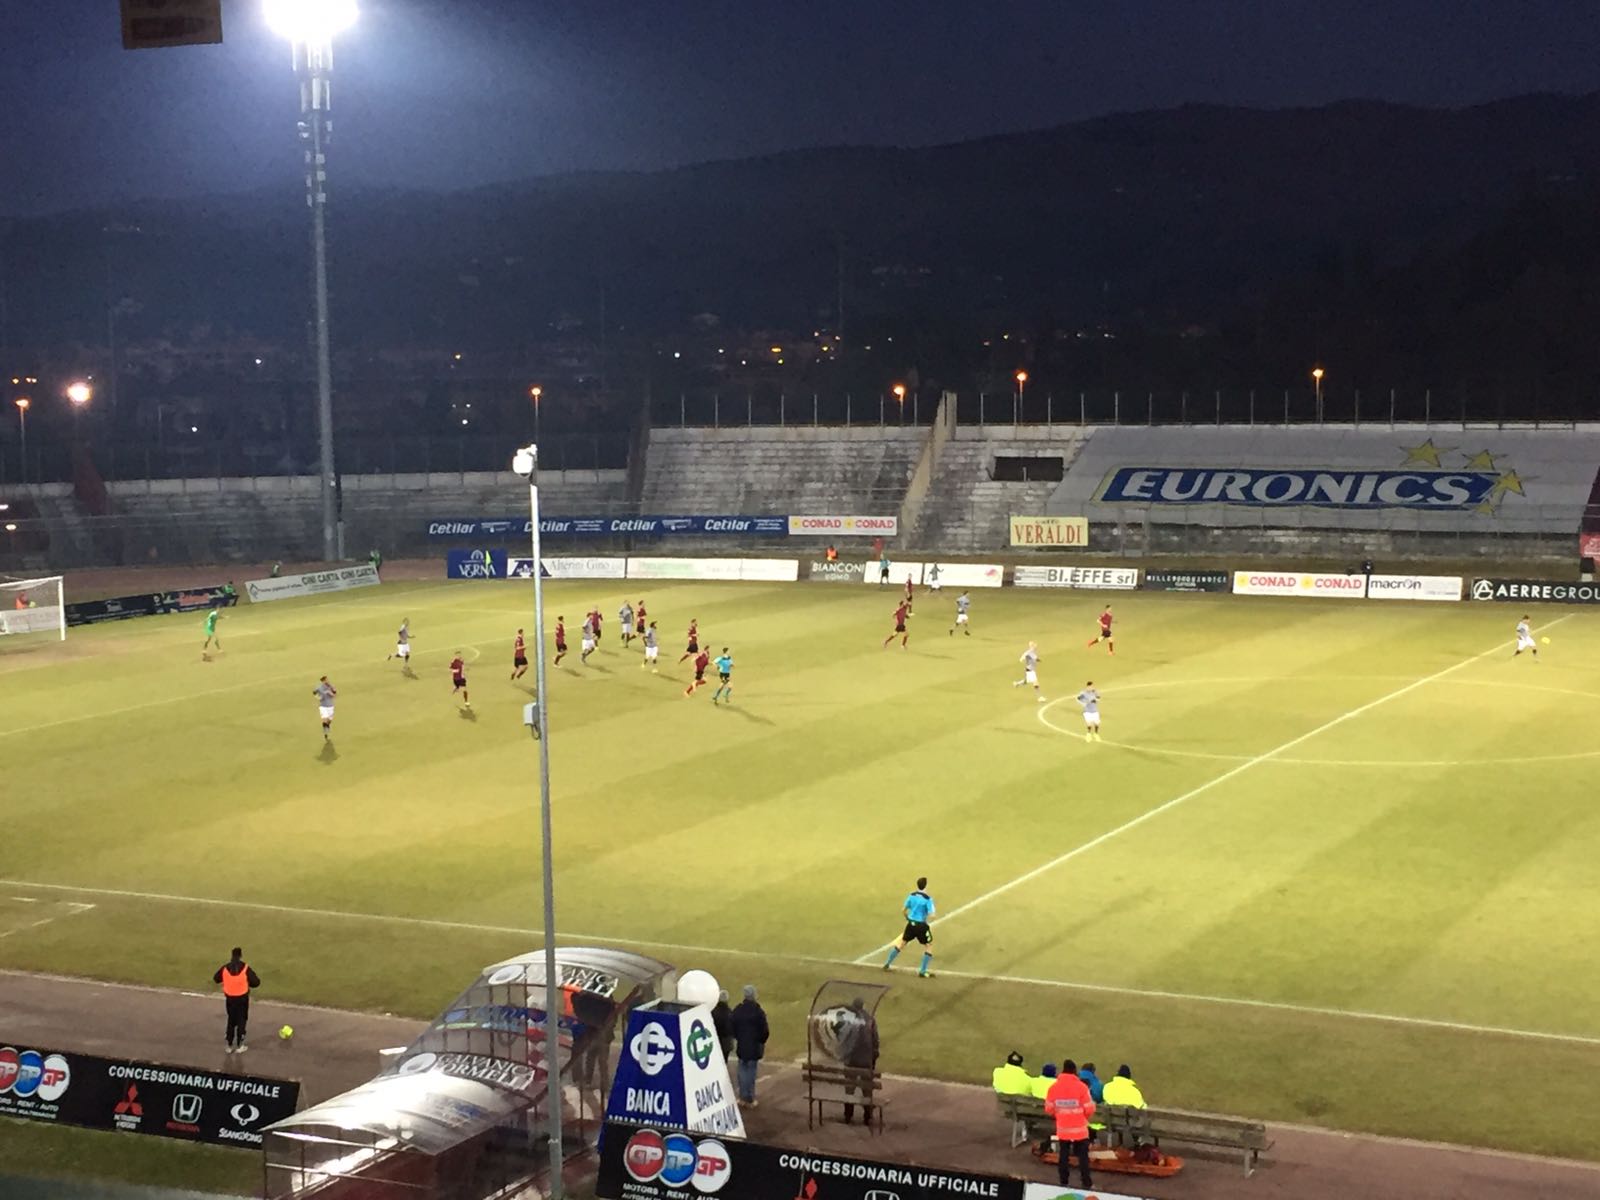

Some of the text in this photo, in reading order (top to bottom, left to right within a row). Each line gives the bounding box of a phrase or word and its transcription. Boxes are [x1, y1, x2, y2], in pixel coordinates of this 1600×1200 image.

[1121, 470, 1474, 505] EURONICS
[429, 522, 476, 535] Cetilar
[524, 520, 570, 533] Ctilar
[610, 519, 657, 532] Cetilar
[704, 518, 751, 532] Cetilar
[802, 519, 841, 528] CONAD
[855, 519, 895, 529] CONAD
[1014, 524, 1083, 544] VERALDI
[811, 562, 865, 573] BIANCONI
[1047, 569, 1113, 584] BI.EFFE
[1116, 572, 1135, 585] srl
[1249, 576, 1297, 588] CONAD
[1314, 578, 1362, 589] CONAD
[1370, 577, 1422, 590] macron
[108, 1065, 280, 1098] CONCESSIONARIA UFFICIALE
[625, 1086, 671, 1117] BANCA
[694, 1080, 724, 1112] BANCA
[779, 1154, 999, 1197] CONCESSIONARIA UFFICIALE
[622, 1183, 659, 1195] MOTORS
[666, 1189, 689, 1200] RENT
